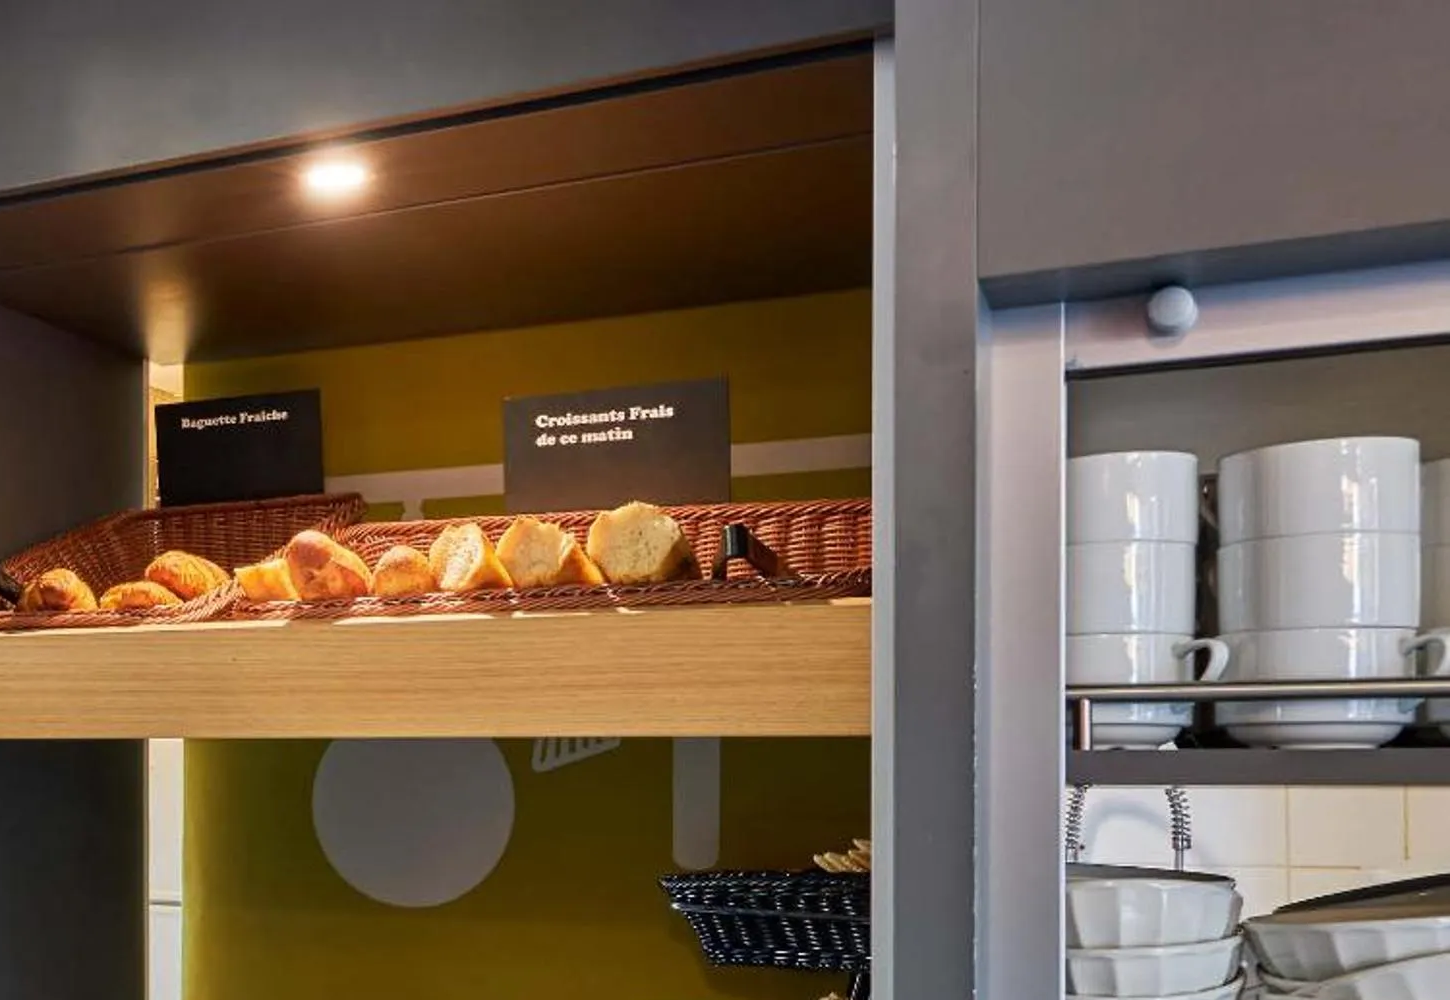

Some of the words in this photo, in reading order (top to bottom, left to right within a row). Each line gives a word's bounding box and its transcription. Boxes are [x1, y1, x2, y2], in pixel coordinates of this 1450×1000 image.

[181, 415, 237, 430] Baguette
[535, 409, 626, 428] Croissants
[629, 404, 674, 421] Frais
[535, 433, 556, 447] de
[559, 434, 578, 445] ce
[581, 426, 633, 444] matin
